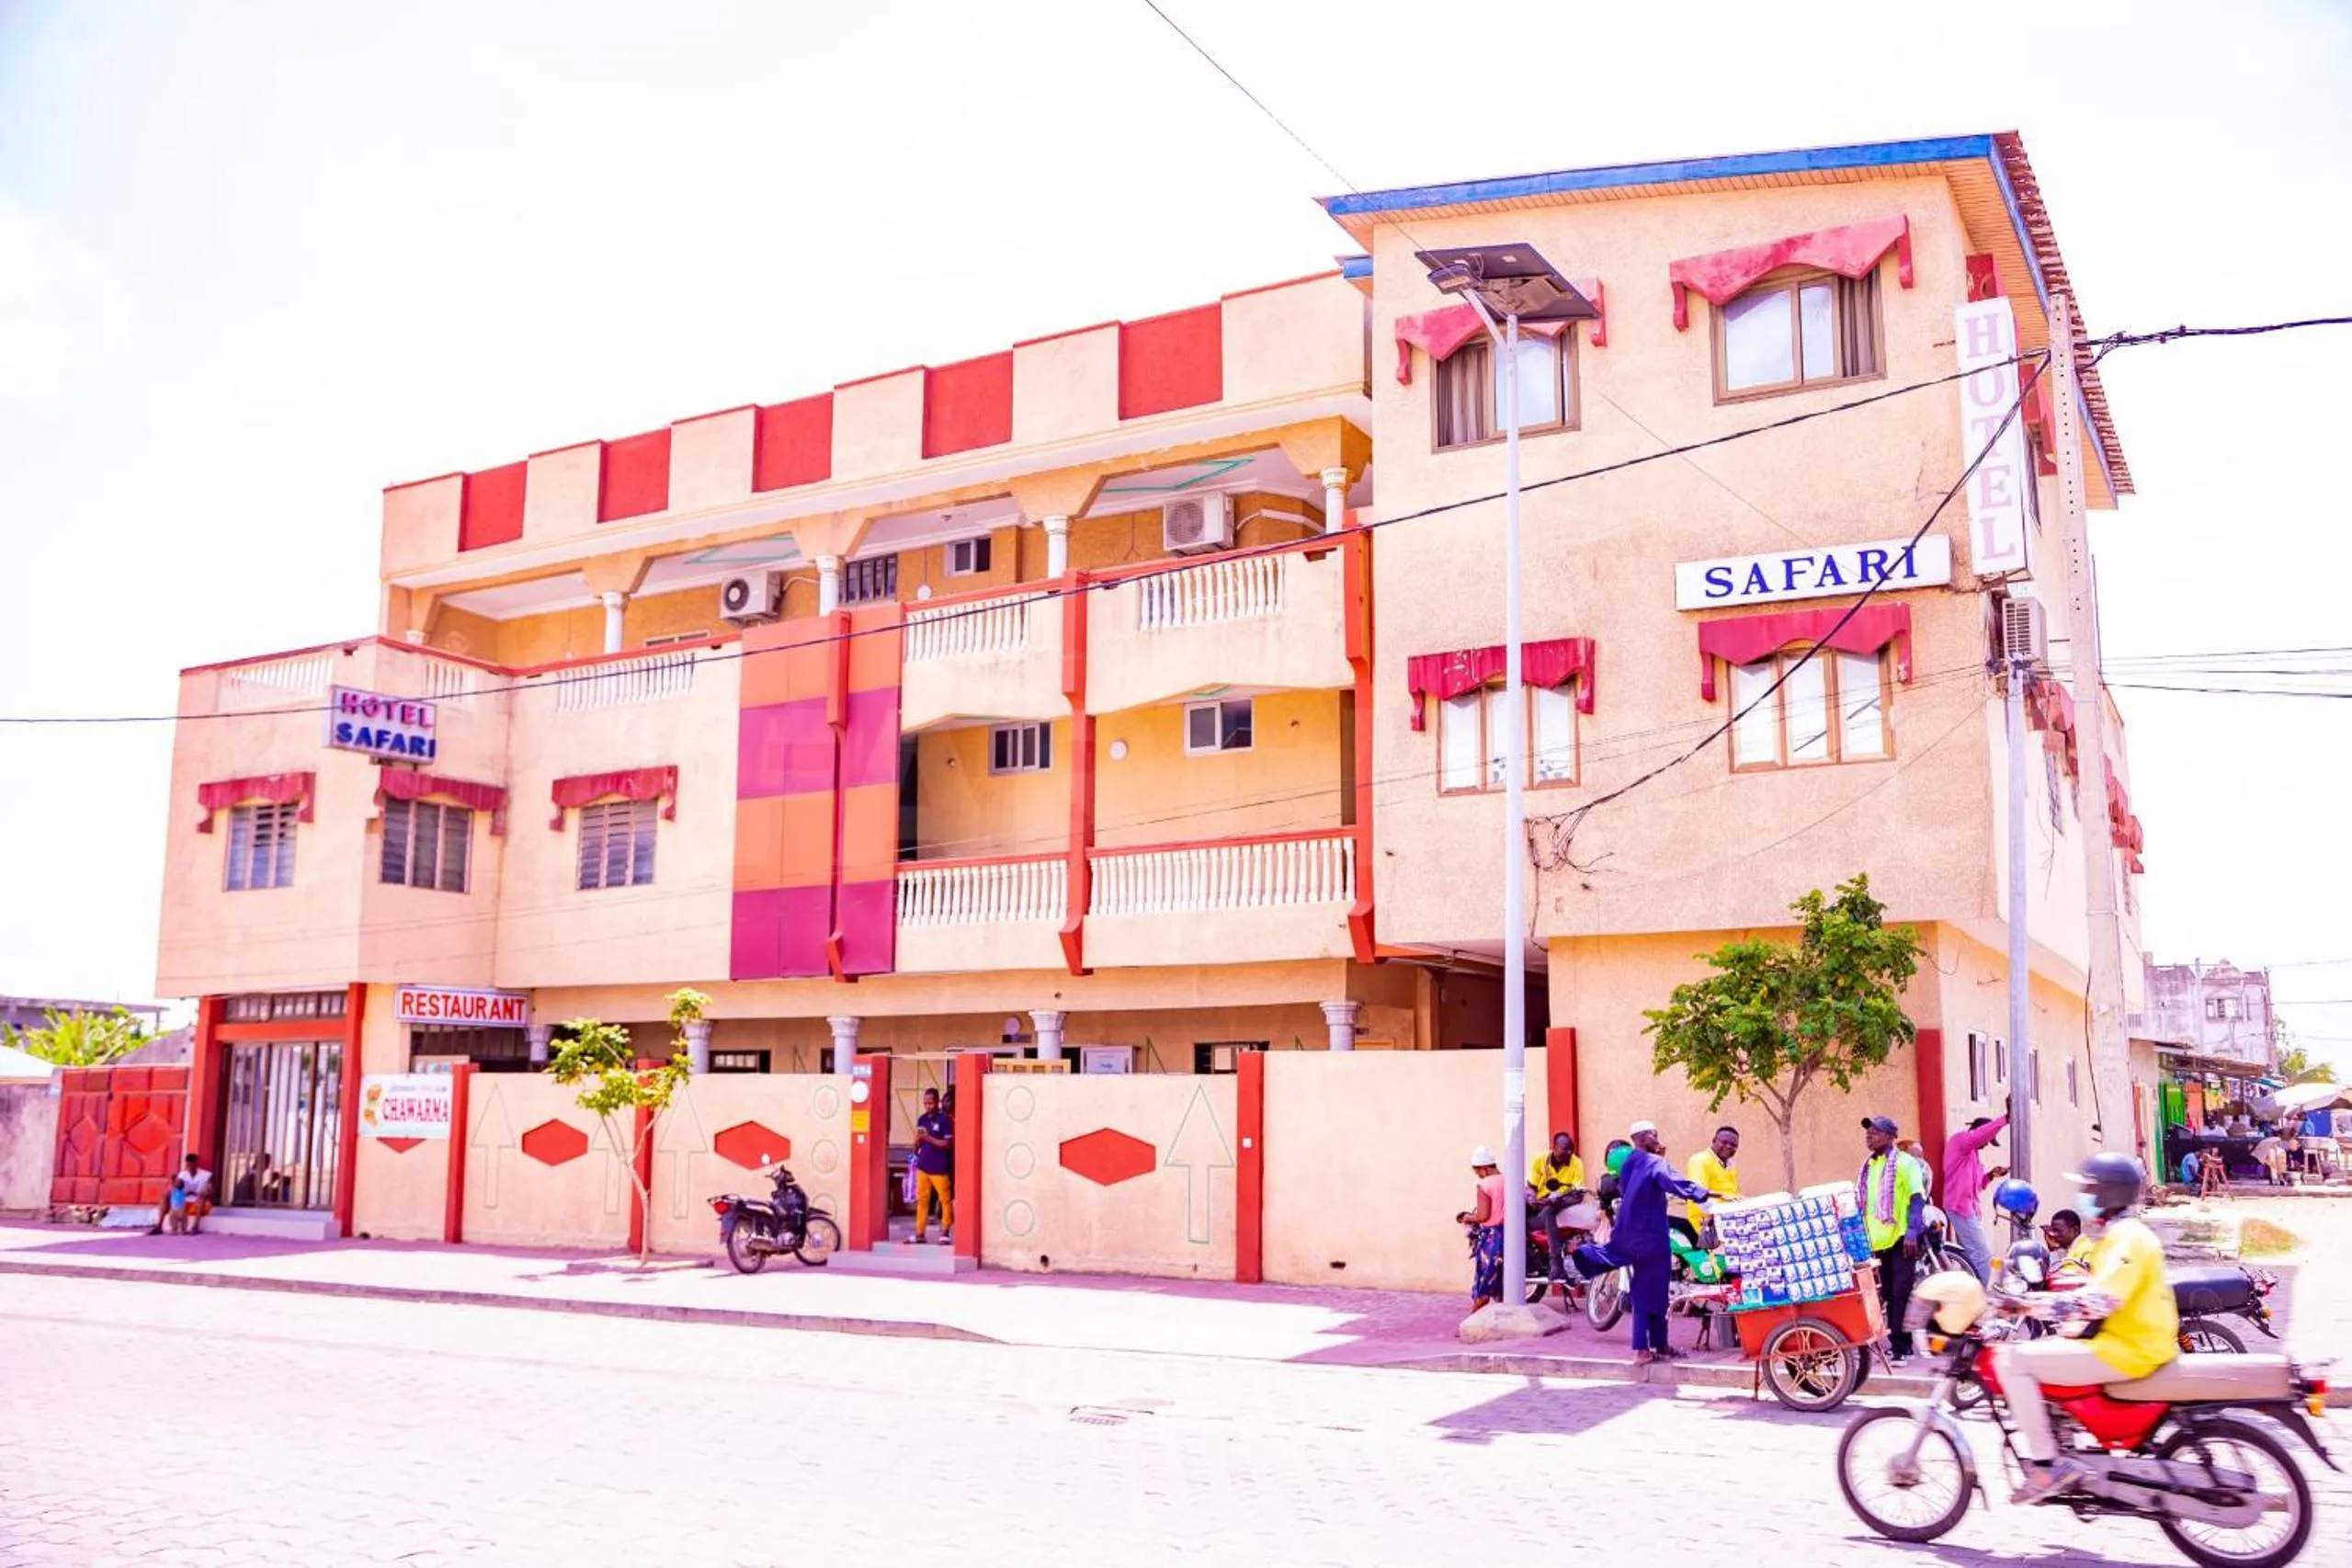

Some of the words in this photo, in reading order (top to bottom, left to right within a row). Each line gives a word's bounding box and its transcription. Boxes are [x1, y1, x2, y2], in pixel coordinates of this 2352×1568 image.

[1964, 312, 2017, 560] HOTEL
[1704, 545, 1918, 598] SAFARI
[336, 722, 437, 758] SAFARI
[402, 992, 526, 1021] RESTAURANT
[382, 1096, 449, 1123] CHAWARMA
